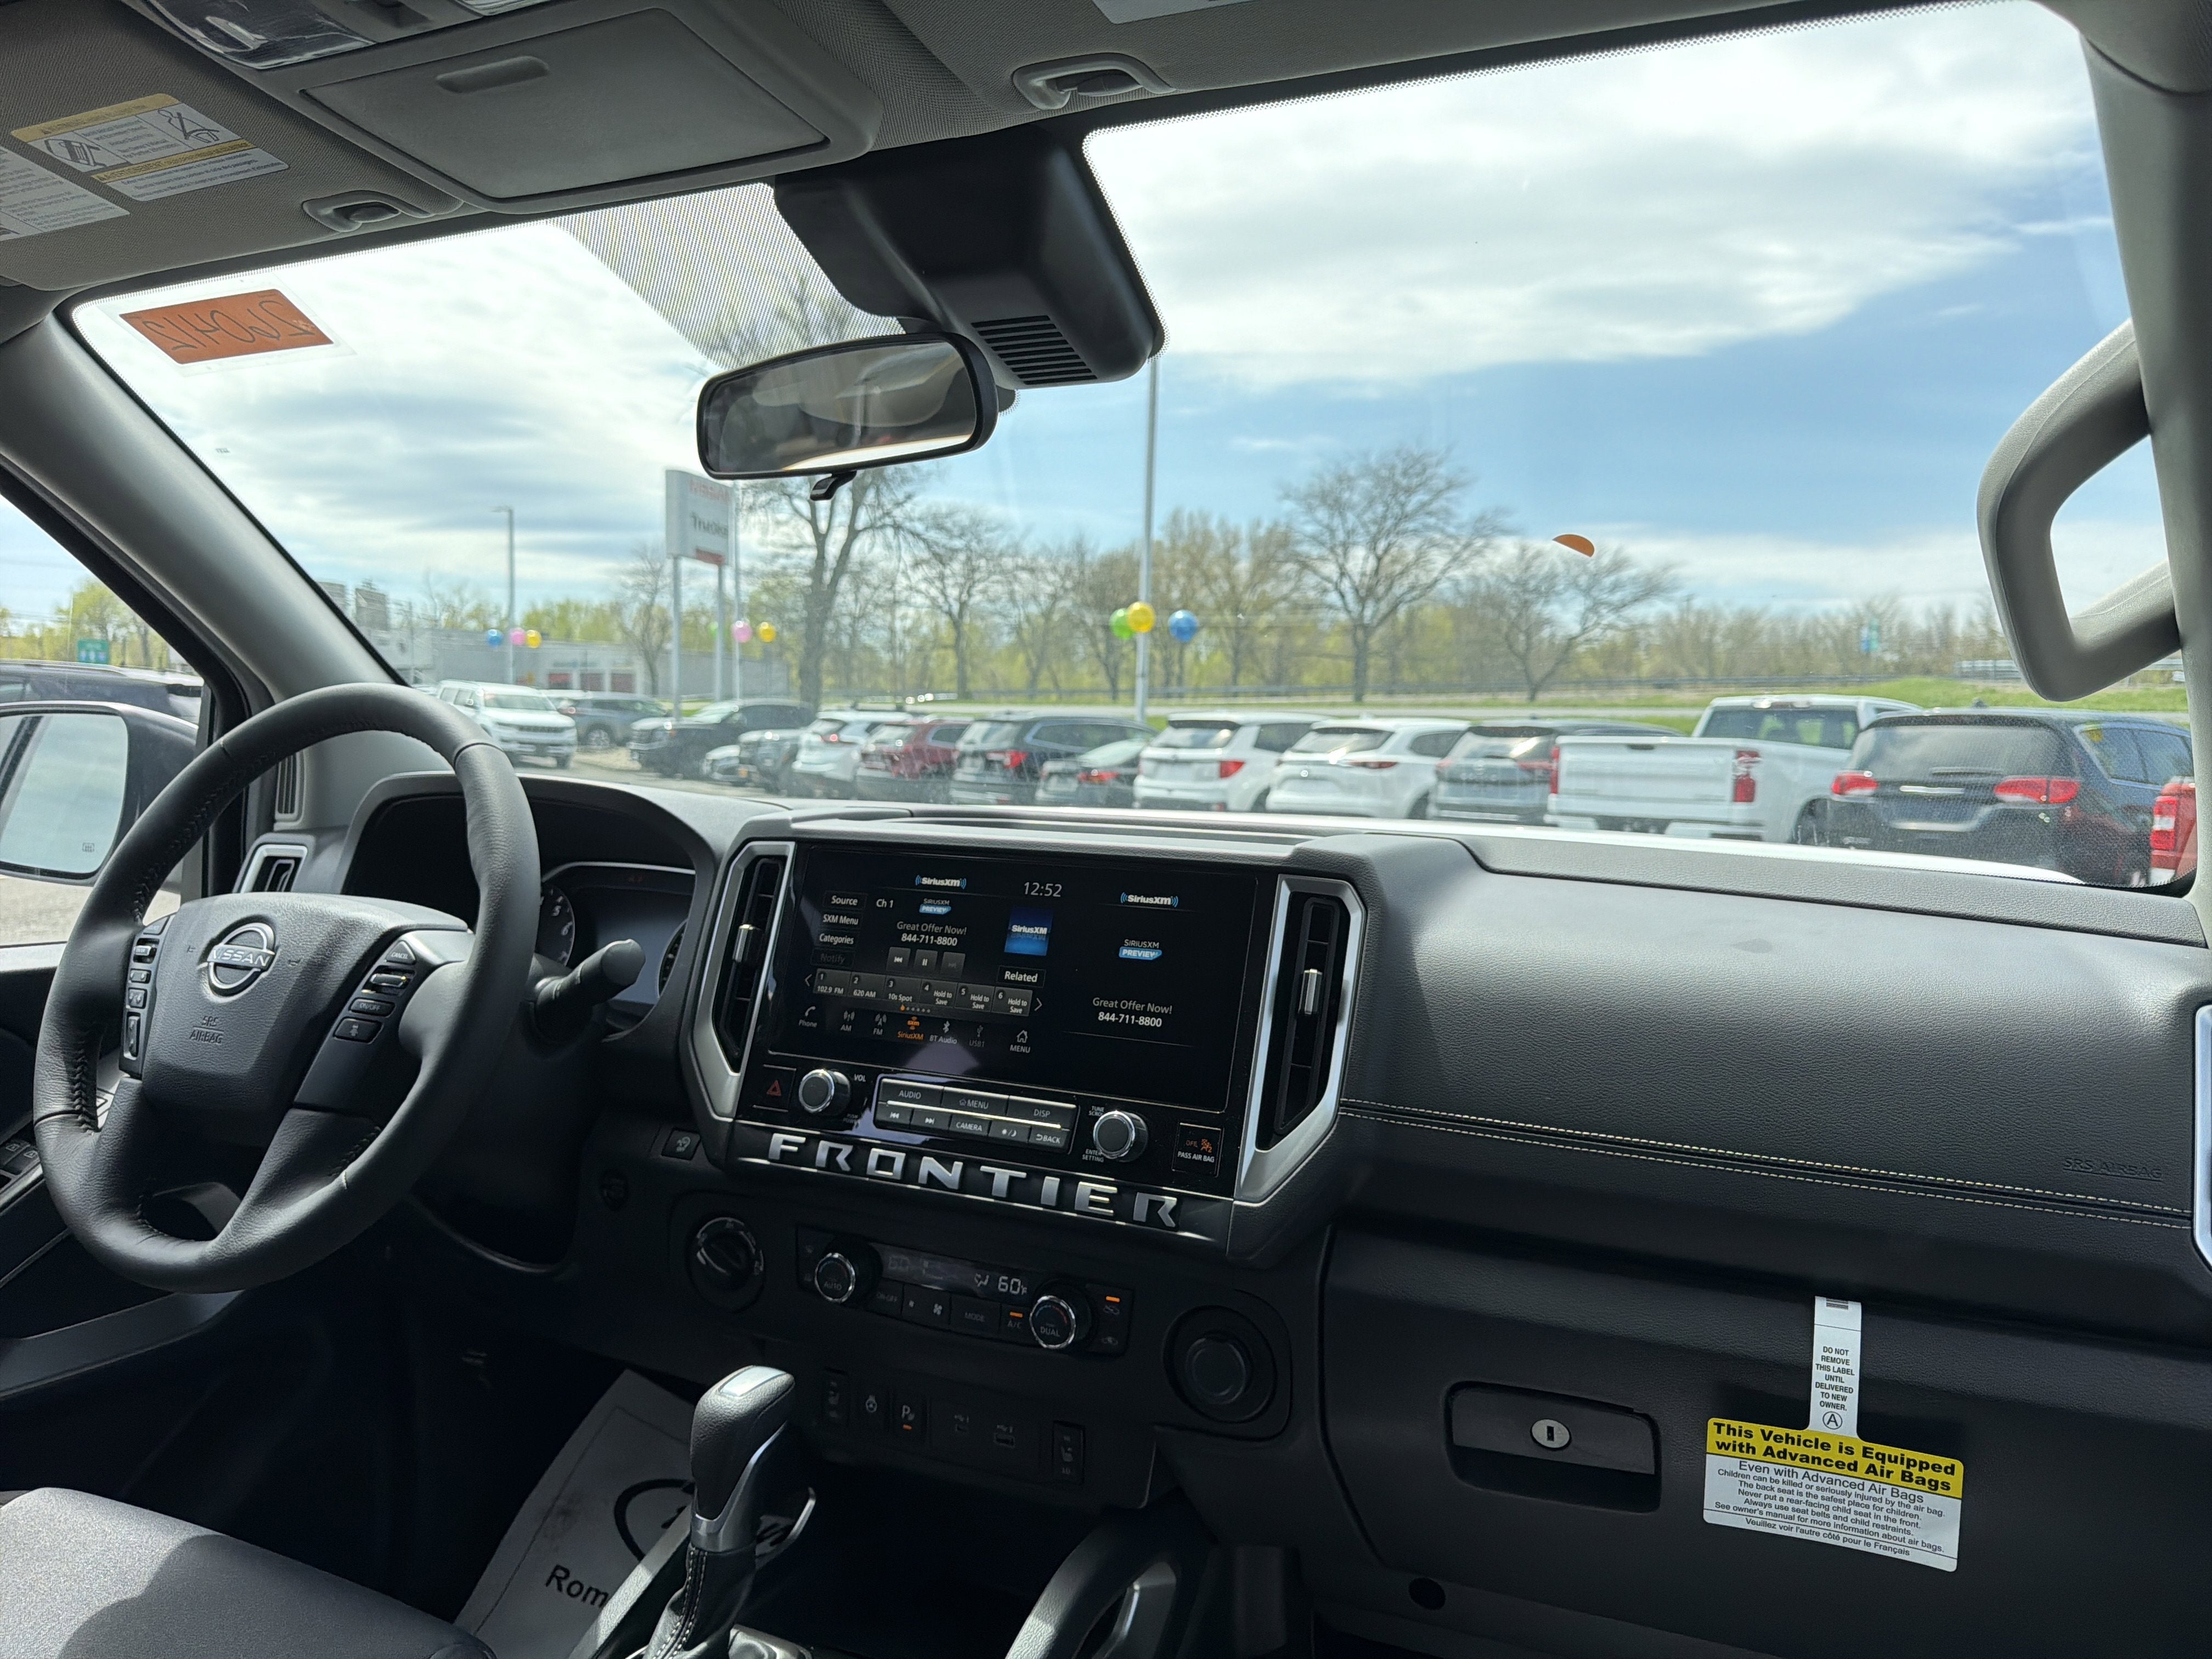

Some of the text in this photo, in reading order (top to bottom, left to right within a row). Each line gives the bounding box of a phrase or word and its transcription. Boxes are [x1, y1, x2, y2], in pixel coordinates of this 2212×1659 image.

[1024, 882, 1062, 898] 12:52
[831, 895, 858, 906] Source
[876, 899, 894, 908] Ch 1
[823, 913, 859, 925] SXM Menu
[897, 921, 967, 935] Great Offer Now!
[819, 933, 854, 945] Categories
[901, 933, 957, 946] 844-711-8800
[1124, 939, 1159, 949] SIRIUSXM
[212, 949, 270, 967] NISSAN
[1122, 949, 1158, 958] PREVIEW
[1005, 970, 1038, 983] Related
[817, 985, 833, 994] 102.9
[898, 994, 912, 1003] Spot
[1008, 997, 1020, 1006] Hold
[1092, 997, 1172, 1014] Great Offer Now!
[799, 1019, 817, 1028] Phone
[1098, 1012, 1162, 1028] 844-711-8800
[897, 1031, 924, 1041] SiriusXM
[938, 1036, 957, 1044] Audio
[1009, 1045, 1030, 1053] MENU
[854, 1073, 866, 1082] VOL
[899, 1090, 922, 1099] AUDIO
[967, 1099, 989, 1109] MENU
[1033, 1108, 1051, 1118] DISP
[956, 1121, 983, 1131] CAMERA
[1043, 1135, 1060, 1144] BACK
[1177, 1151, 1192, 1159] PASS
[769, 1132, 1178, 1228] FRONTIER
[1007, 1321, 1022, 1330] A/C
[1040, 1327, 1060, 1338] DUAL
[1822, 1346, 1849, 1356] DO NOT
[1821, 1355, 1850, 1366] REMOVE
[1815, 1363, 1855, 1376] THIS LABEL
[1825, 1374, 1844, 1384] UNTIL
[1815, 1381, 1854, 1394] DELIVERED
[1831, 1393, 1848, 1402] NEW
[1819, 1401, 1847, 1412] OWNER.
[1826, 1413, 1838, 1427] A
[1713, 1422, 1956, 1476] This Vehicle is Equipped
[1716, 1440, 1951, 1492] with Advanced Air Bags
[1739, 1460, 1924, 1504] Even with Advanced Air Bags
[1718, 1469, 1751, 1480] Children
[1770, 1476, 1780, 1485] be
[1782, 1479, 1803, 1488] killed
[1816, 1486, 1852, 1498] seriously
[1855, 1492, 1883, 1503] injured
[1885, 1498, 1895, 1508] by
[1898, 1500, 1911, 1509] the
[1914, 1504, 1925, 1513] air
[1927, 1506, 1945, 1517] bag.
[1739, 1480, 1754, 1488] The
[1756, 1483, 1775, 1492] back
[1778, 1487, 1795, 1496] seat
[1805, 1491, 1818, 1499] the
[1821, 1494, 1846, 1505] safest
[1848, 1499, 1870, 1509] place
[1872, 1504, 1884, 1512] for
[1886, 1507, 1921, 1521] children.
[1738, 1488, 1763, 1498] Never
[1764, 1492, 1777, 1502] put
[1786, 1497, 1830, 1511] rear-facing
[1832, 1505, 1852, 1515] child
[1853, 1509, 1872, 1519] seat
[1874, 1512, 1881, 1521] in
[1883, 1515, 1897, 1523] the
[1899, 1517, 1921, 1529] front.
[1744, 1498, 1773, 1509] Always
[1791, 1506, 1809, 1515] seat
[1811, 1509, 1831, 1519] belts
[1832, 1514, 1848, 1522] and
[1850, 1517, 1870, 1527] child
[1872, 1521, 1914, 1536] restraints.
[1715, 1502, 1944, 1553] See owner's manual for more information about air bags.
[1745, 1517, 1910, 1556] Veuillez voir l'autre côté pour le Français
